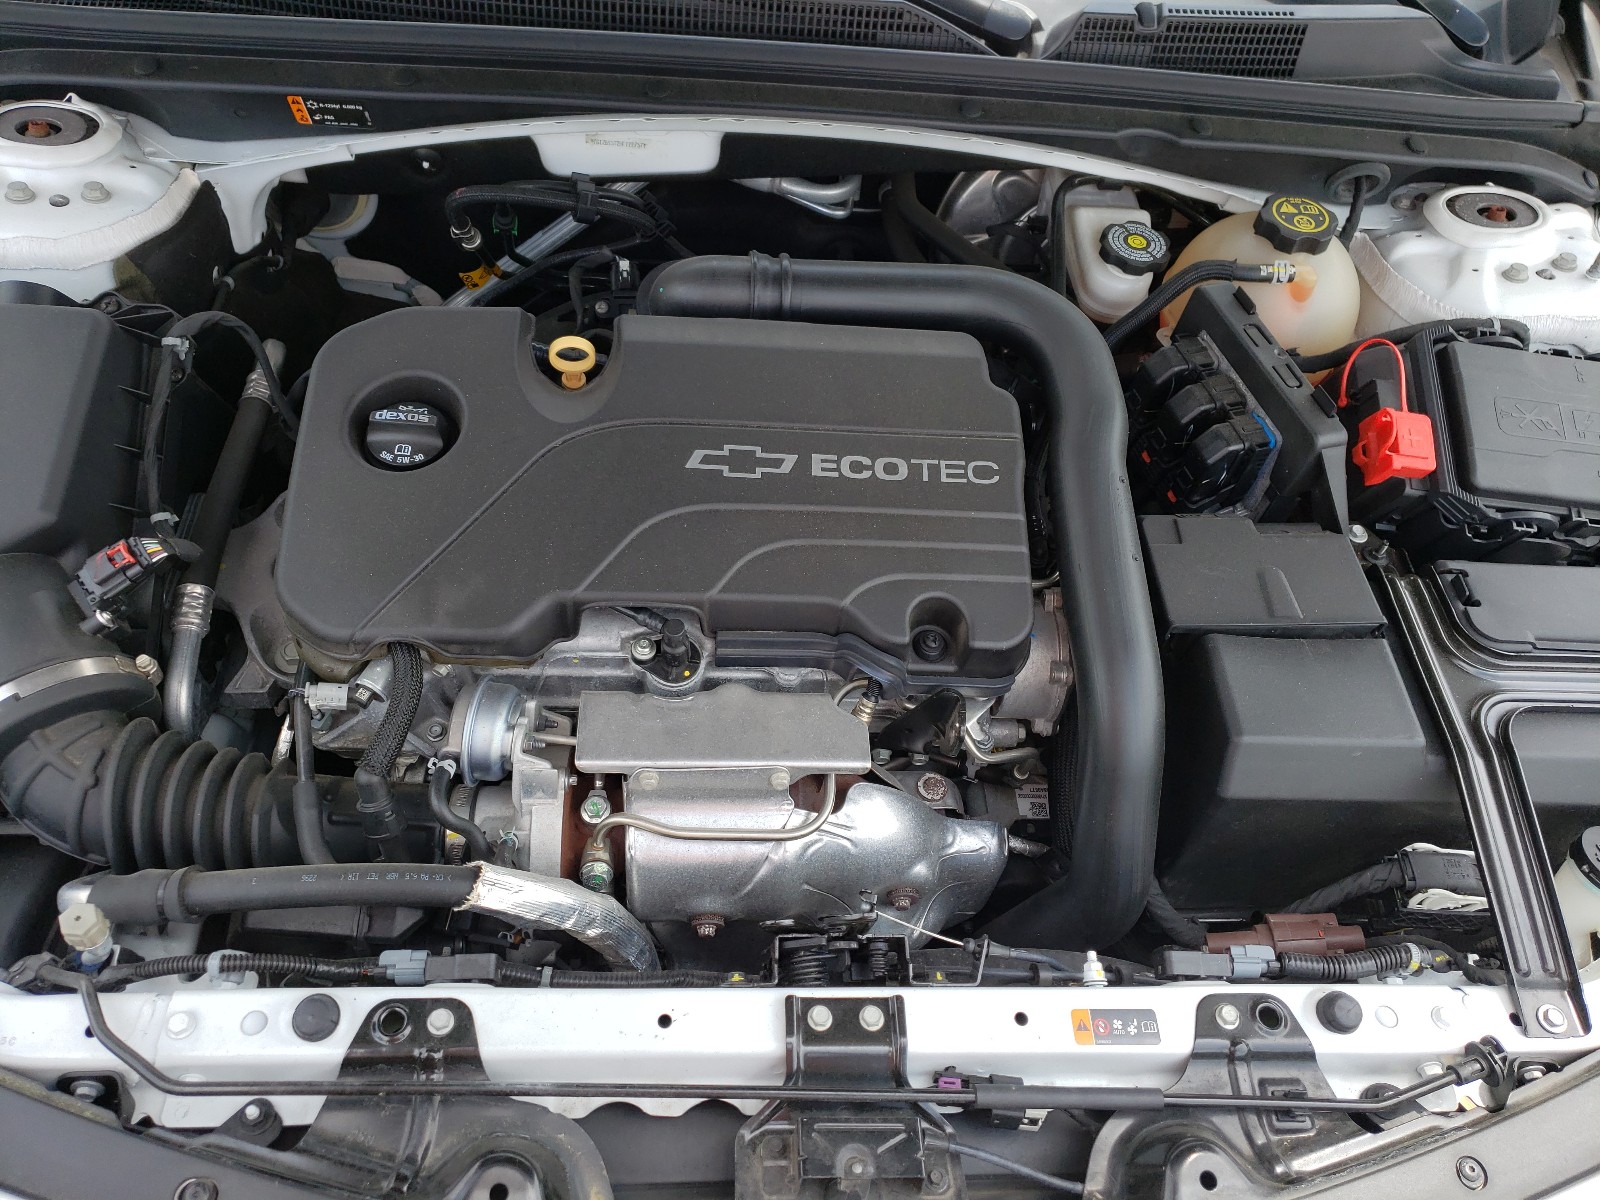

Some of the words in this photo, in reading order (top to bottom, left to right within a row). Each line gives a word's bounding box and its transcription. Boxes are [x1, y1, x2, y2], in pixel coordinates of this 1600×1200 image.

[375, 410, 431, 423] dexos
[380, 451, 394, 462] SAE
[396, 454, 424, 464] 5W-30
[811, 453, 1000, 484] ECOTEC
